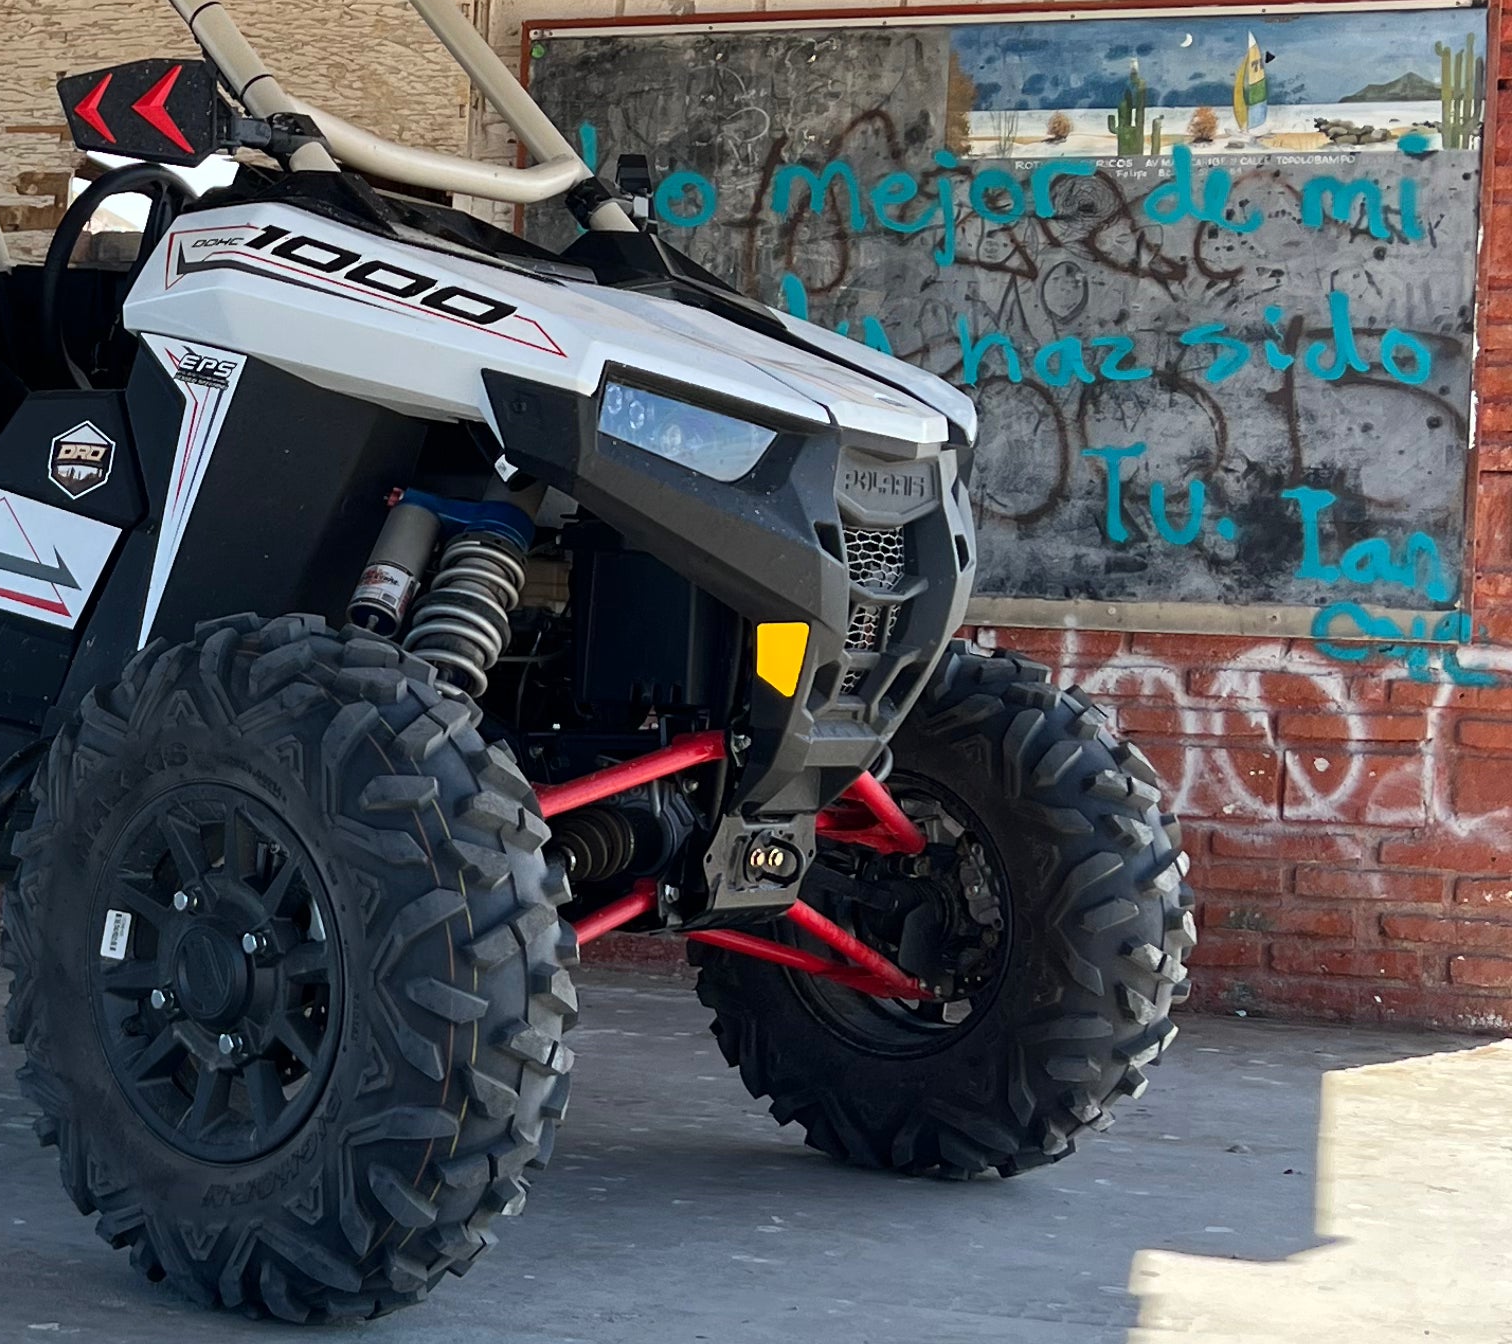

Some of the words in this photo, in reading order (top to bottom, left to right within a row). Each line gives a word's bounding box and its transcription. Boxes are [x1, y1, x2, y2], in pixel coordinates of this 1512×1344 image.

[1143, 144, 1264, 234] de
[1299, 132, 1434, 241] mi
[192, 237, 244, 248] DOHC
[246, 225, 517, 325] 1000
[179, 353, 237, 379] EPS
[1179, 290, 1433, 386] sido
[845, 469, 926, 497] POLARIS
